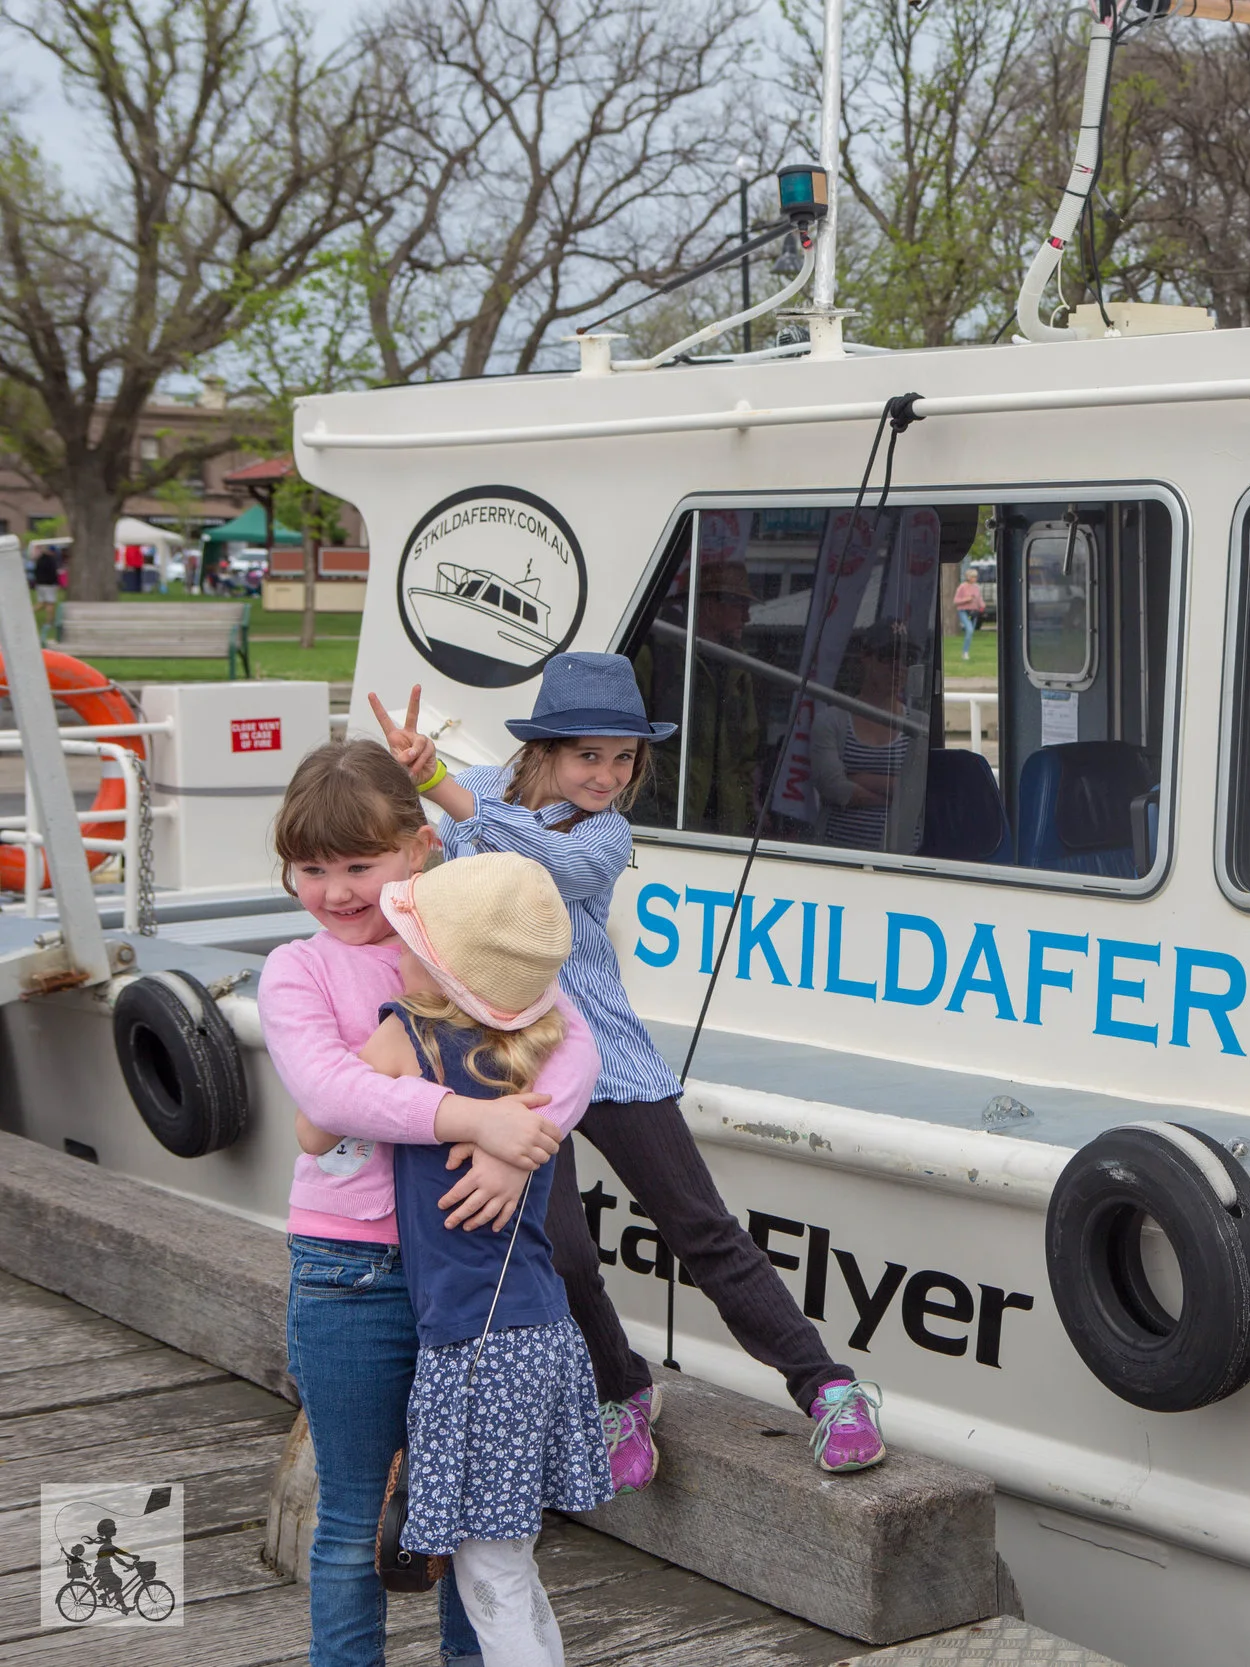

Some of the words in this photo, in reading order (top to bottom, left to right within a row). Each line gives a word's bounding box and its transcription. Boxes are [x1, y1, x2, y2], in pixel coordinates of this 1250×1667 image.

[414, 506, 569, 565] STKILDAFERRY.COM.AU
[231, 722, 257, 732] CLOSE
[257, 721, 280, 731] VENT
[239, 732, 250, 740] IN
[250, 731, 272, 740] CASE
[240, 740, 252, 749] OF
[253, 739, 273, 748] FIRE
[746, 1209, 1035, 1370] Flyer
